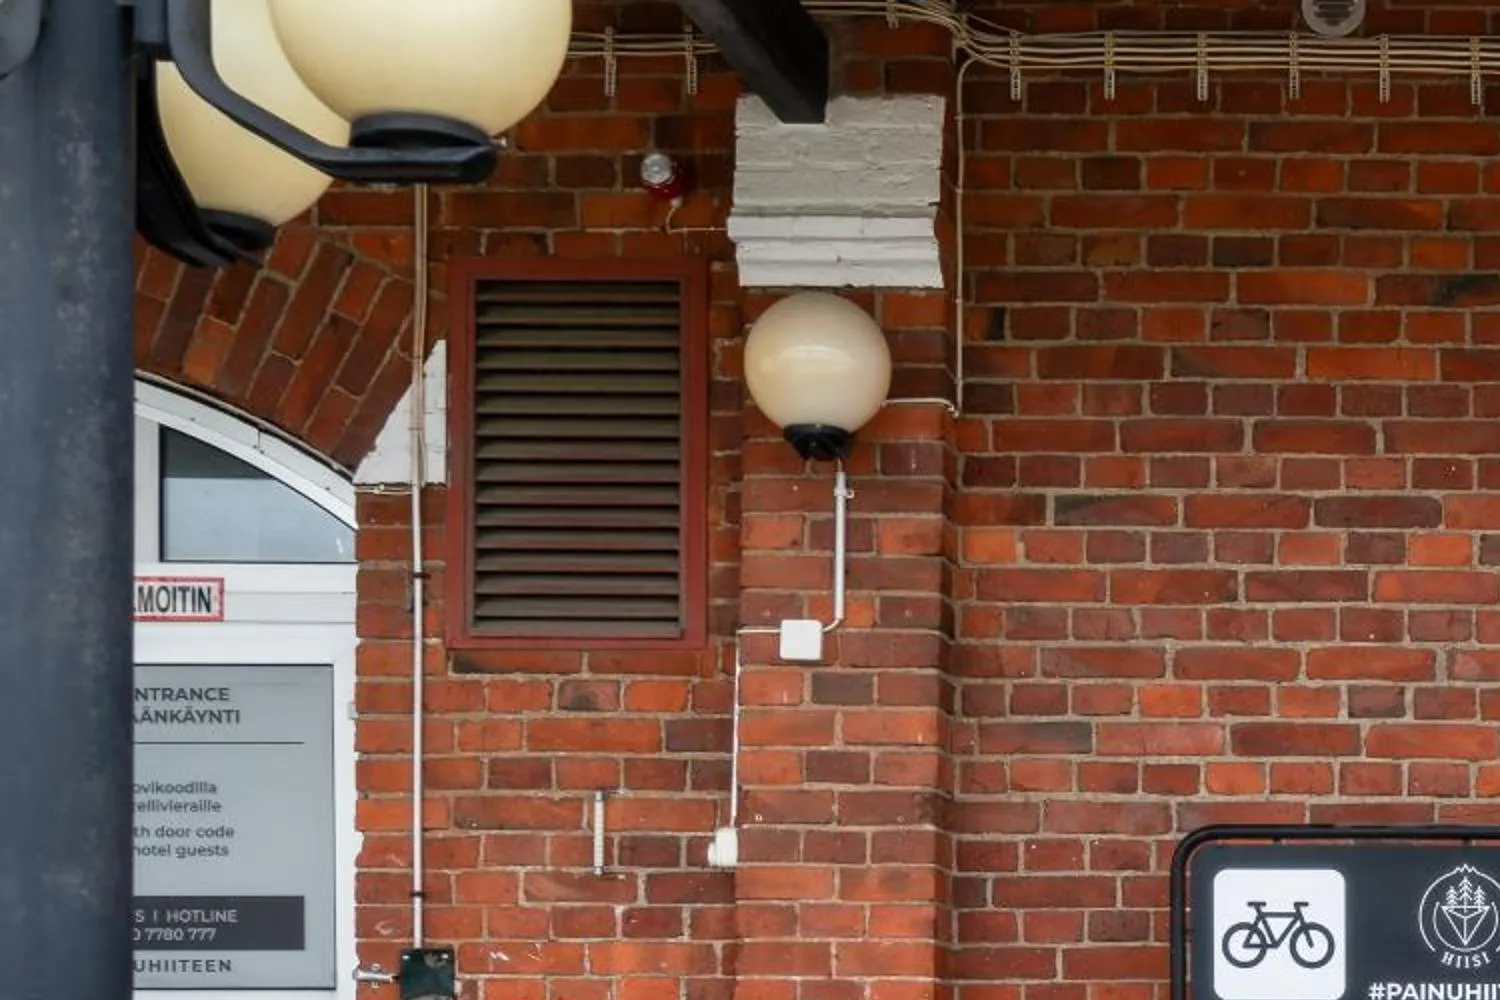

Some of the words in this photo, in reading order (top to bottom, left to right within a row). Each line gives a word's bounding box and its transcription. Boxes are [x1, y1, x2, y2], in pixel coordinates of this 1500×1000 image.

[137, 585, 211, 613] MOITIN
[134, 687, 230, 701] NTRANCE
[137, 799, 222, 813] ellivieraille
[154, 825, 190, 838] door
[195, 825, 235, 838] code
[175, 845, 229, 859] guests
[166, 909, 238, 923] HOTLINE
[144, 927, 184, 941] 7780
[187, 927, 217, 941] 777
[135, 959, 231, 973] UHIITEEN
[1441, 951, 1491, 969] HIISI
